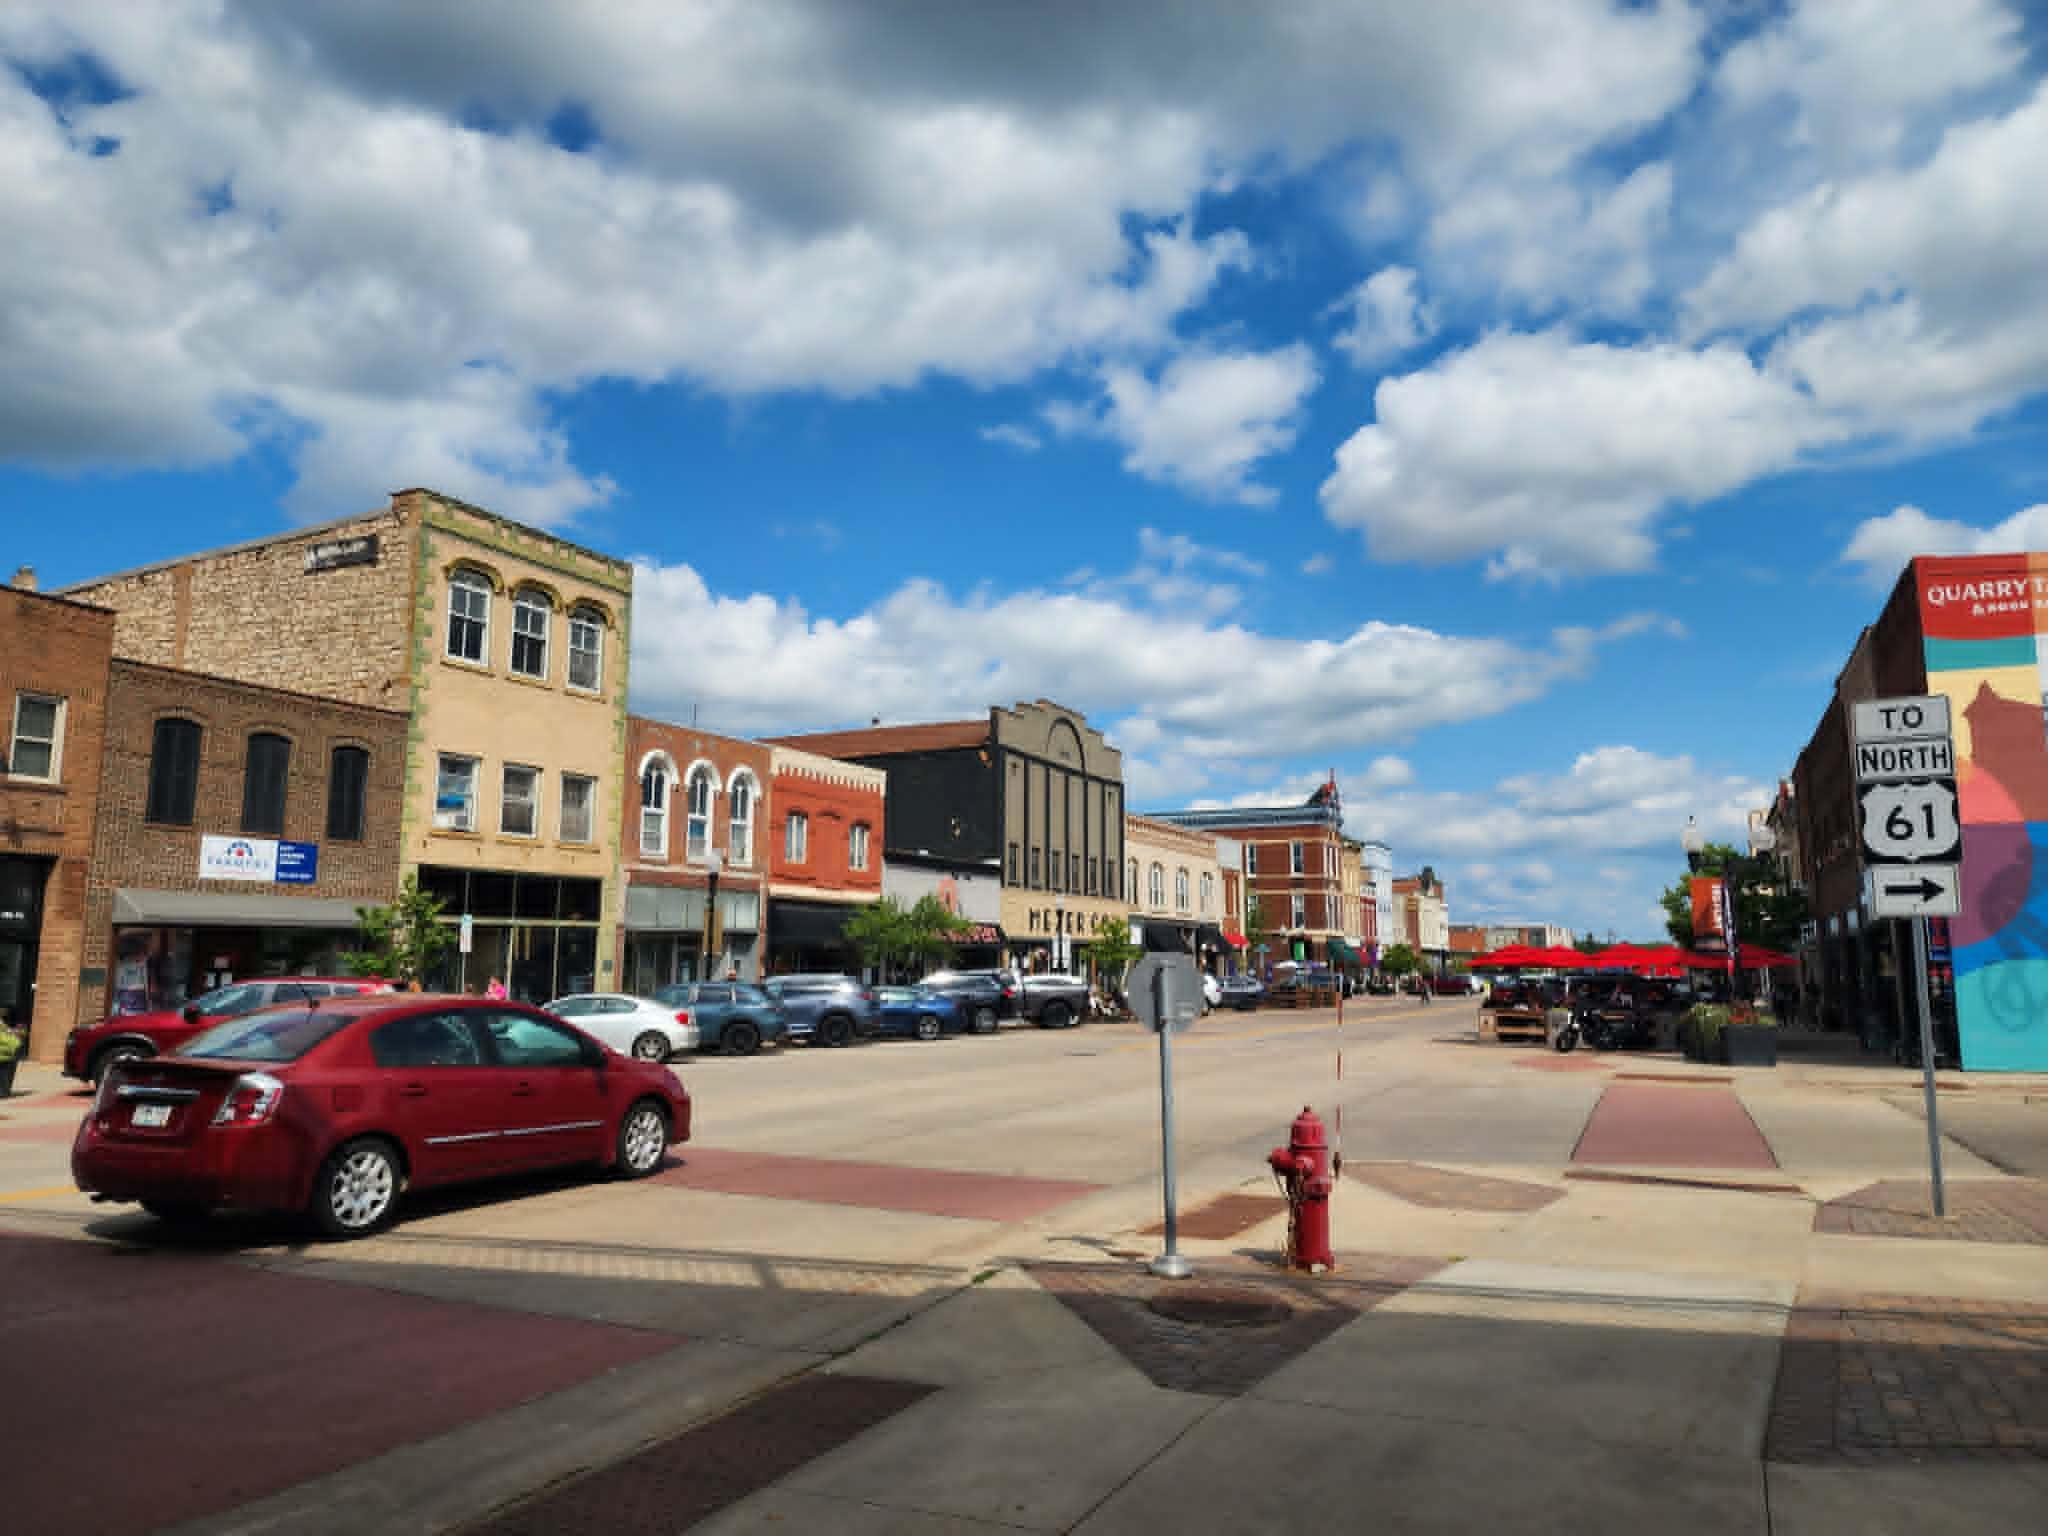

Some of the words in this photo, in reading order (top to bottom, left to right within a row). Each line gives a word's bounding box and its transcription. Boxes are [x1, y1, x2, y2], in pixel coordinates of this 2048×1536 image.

[1927, 579, 2028, 607] QUARRY
[1879, 706, 1923, 729] TO
[1861, 745, 1948, 771] NORTH
[1886, 803, 1935, 841] 61
